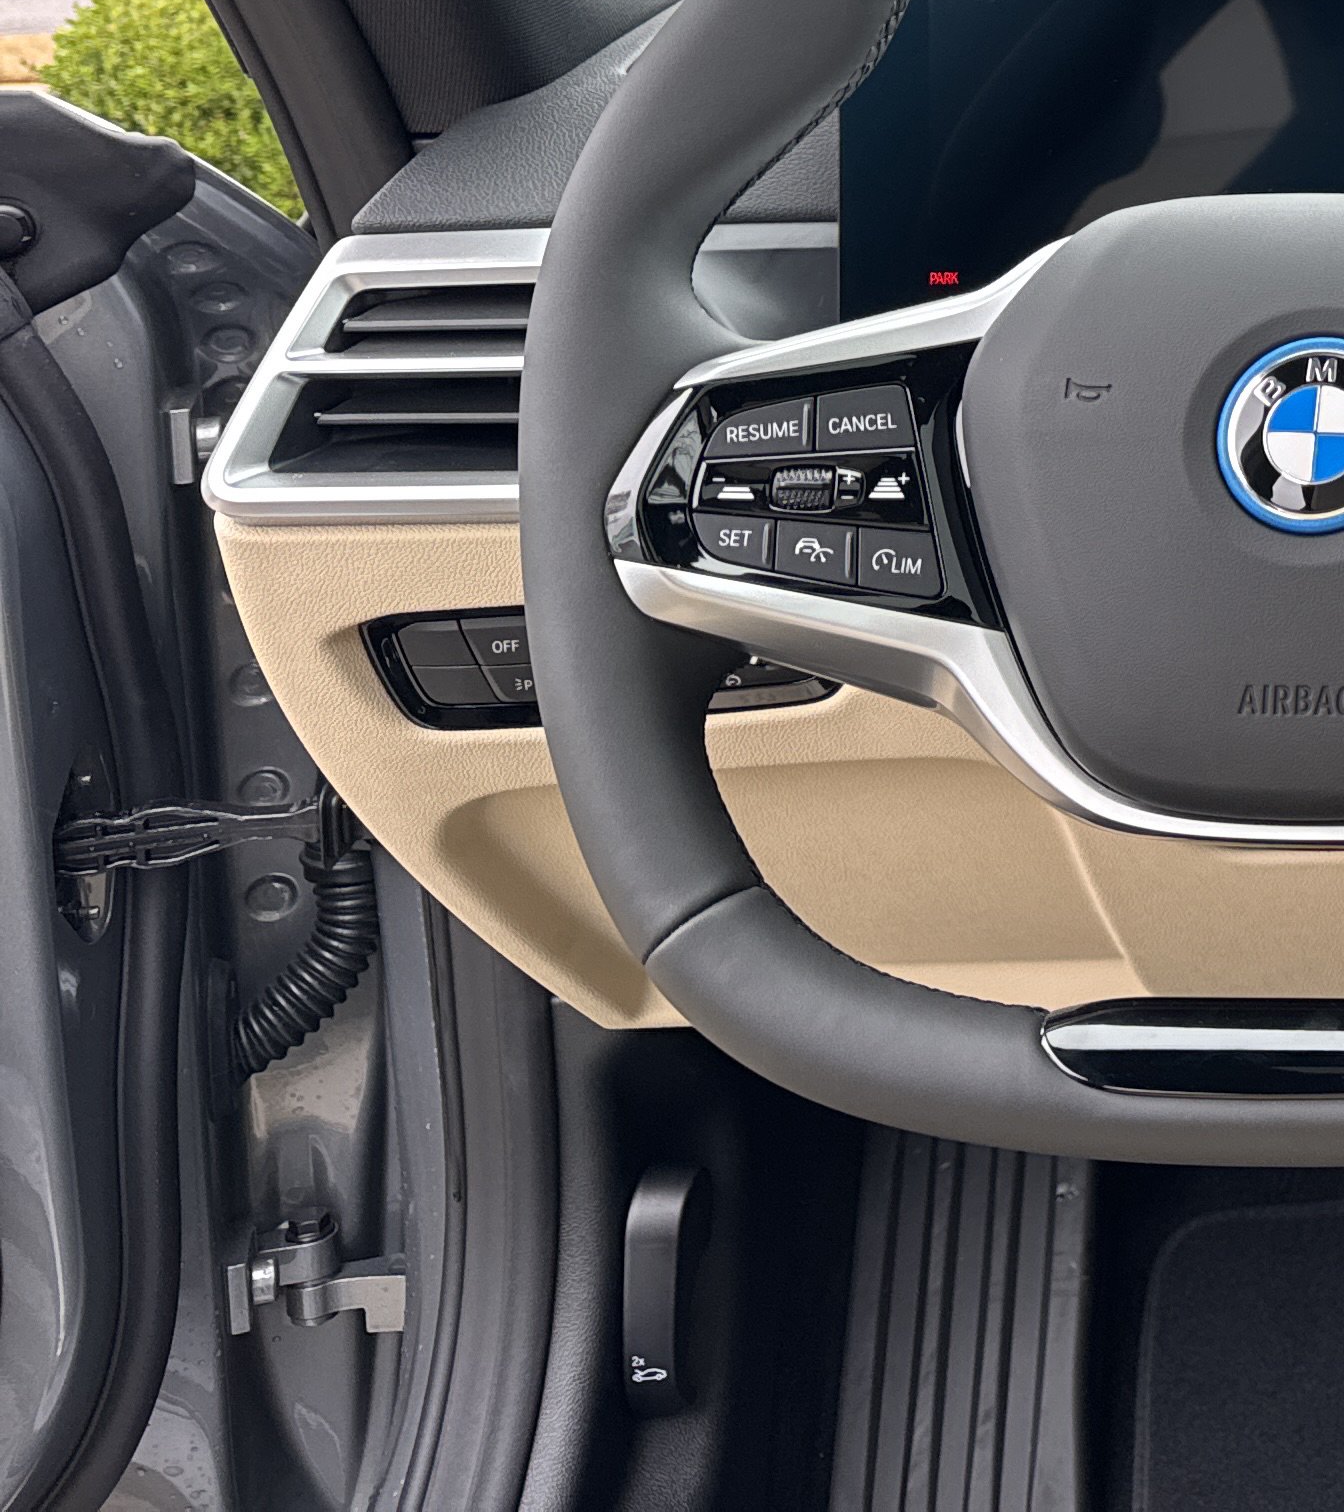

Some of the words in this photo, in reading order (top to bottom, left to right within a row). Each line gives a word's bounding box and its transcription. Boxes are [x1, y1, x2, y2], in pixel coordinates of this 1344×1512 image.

[929, 271, 959, 286] PARK
[725, 419, 800, 444] RESUME
[828, 413, 898, 435] CANCEL
[718, 529, 752, 548] SET
[890, 556, 923, 575] LIM
[491, 639, 520, 654] OFF
[631, 1355, 645, 1368] 2x
